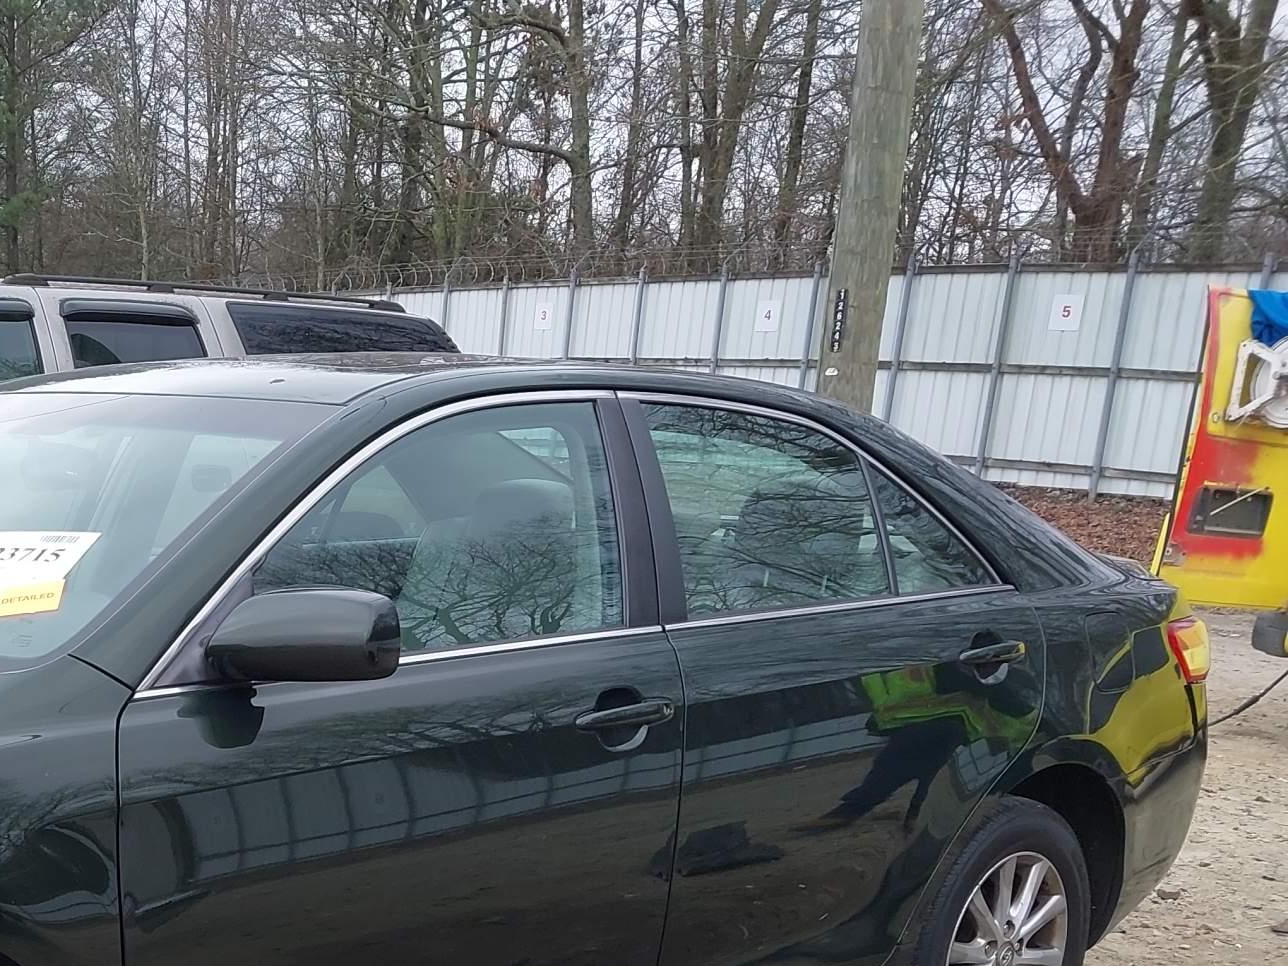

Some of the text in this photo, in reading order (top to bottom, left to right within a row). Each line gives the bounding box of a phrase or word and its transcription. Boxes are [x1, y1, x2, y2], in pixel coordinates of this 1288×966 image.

[540, 310, 548, 321] 3
[764, 309, 772, 321] 4
[1062, 305, 1072, 318] 5
[1, 592, 55, 605] DETAILED
